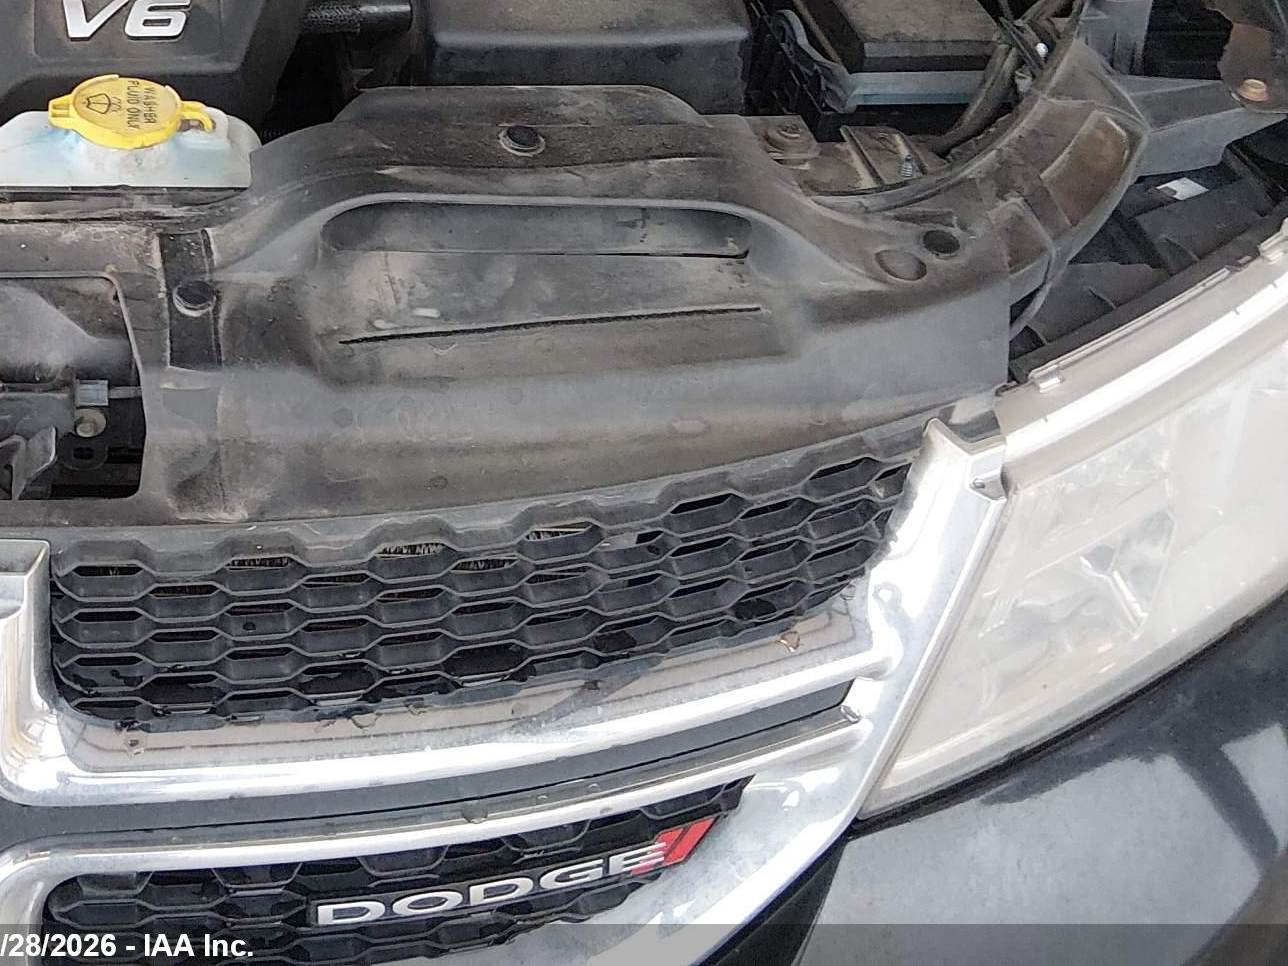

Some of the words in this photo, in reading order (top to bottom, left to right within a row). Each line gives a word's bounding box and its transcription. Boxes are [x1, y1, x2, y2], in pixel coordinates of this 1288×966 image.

[126, 80, 140, 105] FLUID
[143, 87, 157, 124] WASHER
[126, 108, 140, 130] ONLY
[317, 841, 667, 926] DODGE
